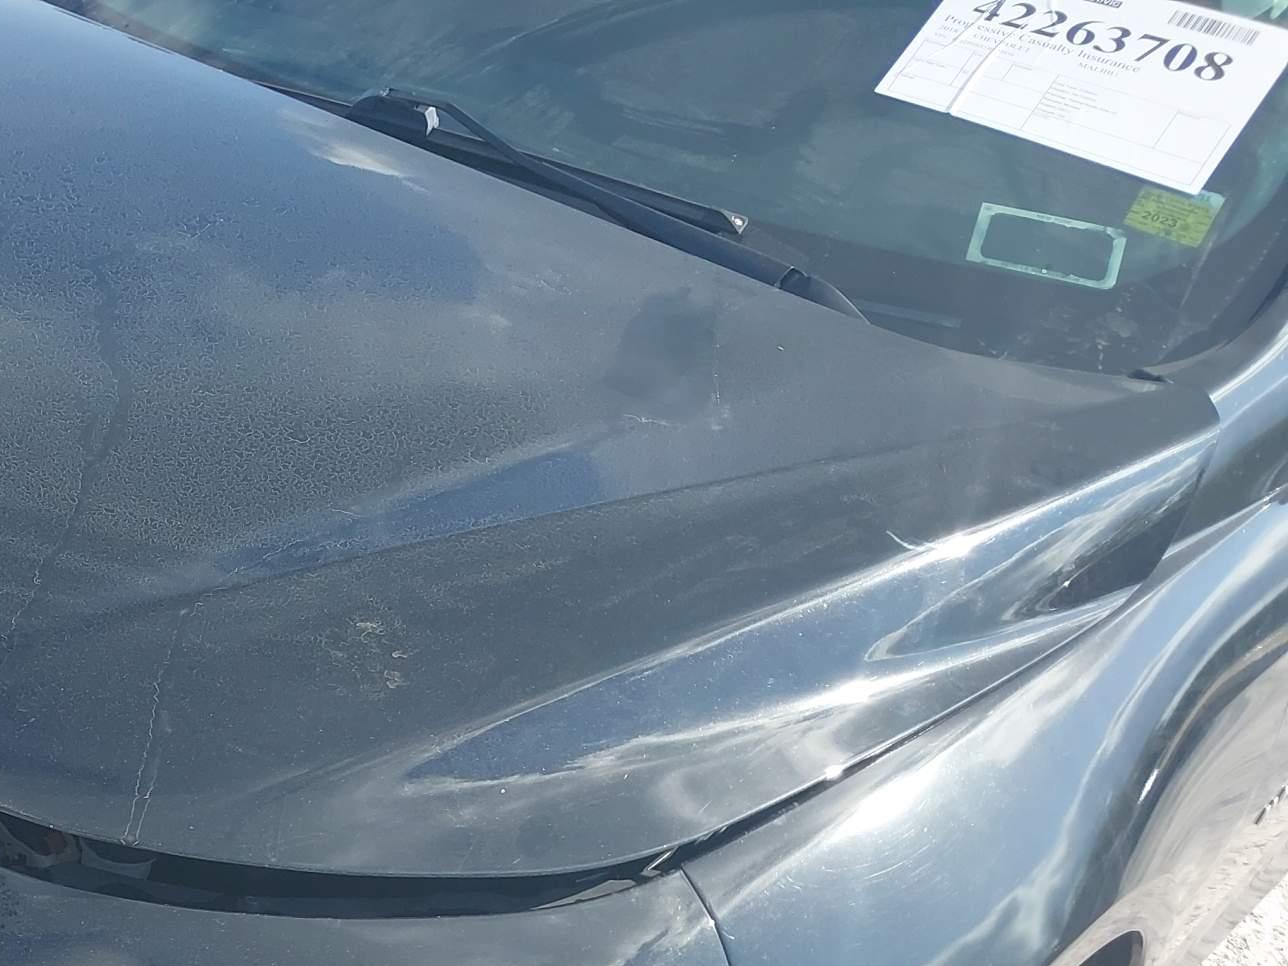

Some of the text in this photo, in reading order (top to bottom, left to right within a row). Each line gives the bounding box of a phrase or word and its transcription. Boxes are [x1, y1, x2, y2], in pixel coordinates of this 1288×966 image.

[944, 15, 1017, 38] Progessiv
[1019, 34, 1072, 56] Casualty
[1078, 50, 1140, 72] Insurance
[973, 0, 1234, 82] 42263708
[974, 33, 1030, 54] CHEVOLET
[1141, 210, 1178, 228] 2023
